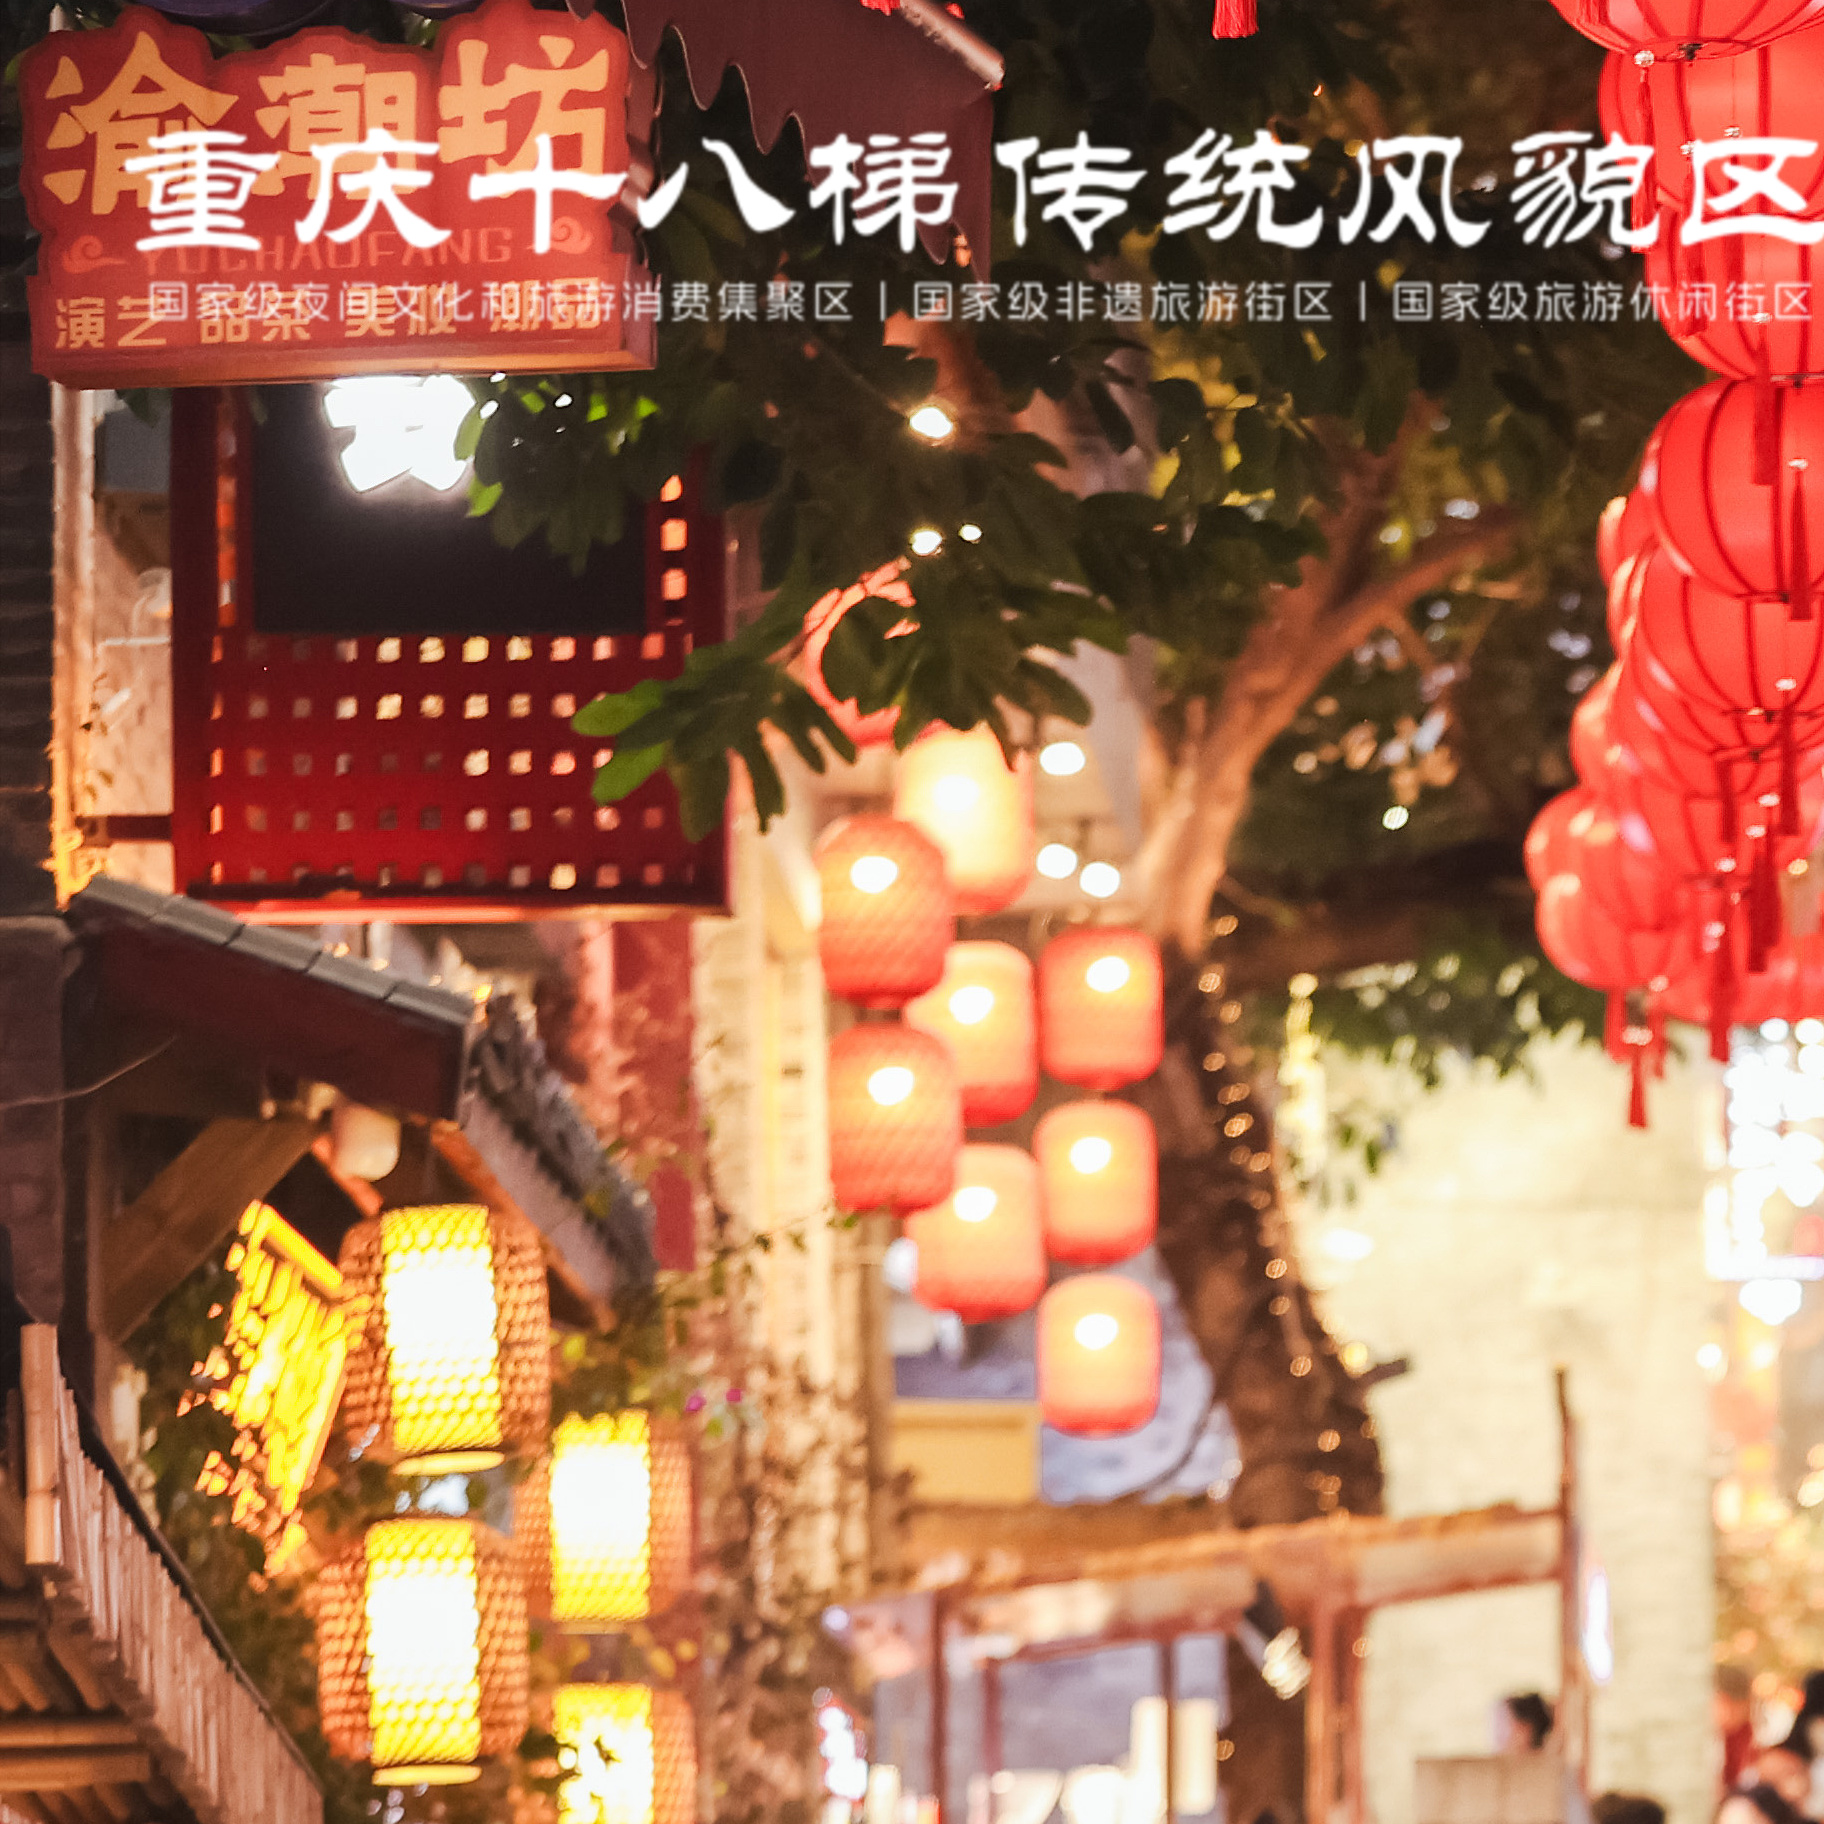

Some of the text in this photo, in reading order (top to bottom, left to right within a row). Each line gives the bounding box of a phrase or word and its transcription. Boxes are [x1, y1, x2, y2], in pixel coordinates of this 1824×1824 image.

[45, 32, 609, 214] 渝潮坊
[55, 295, 167, 348] 演艺
